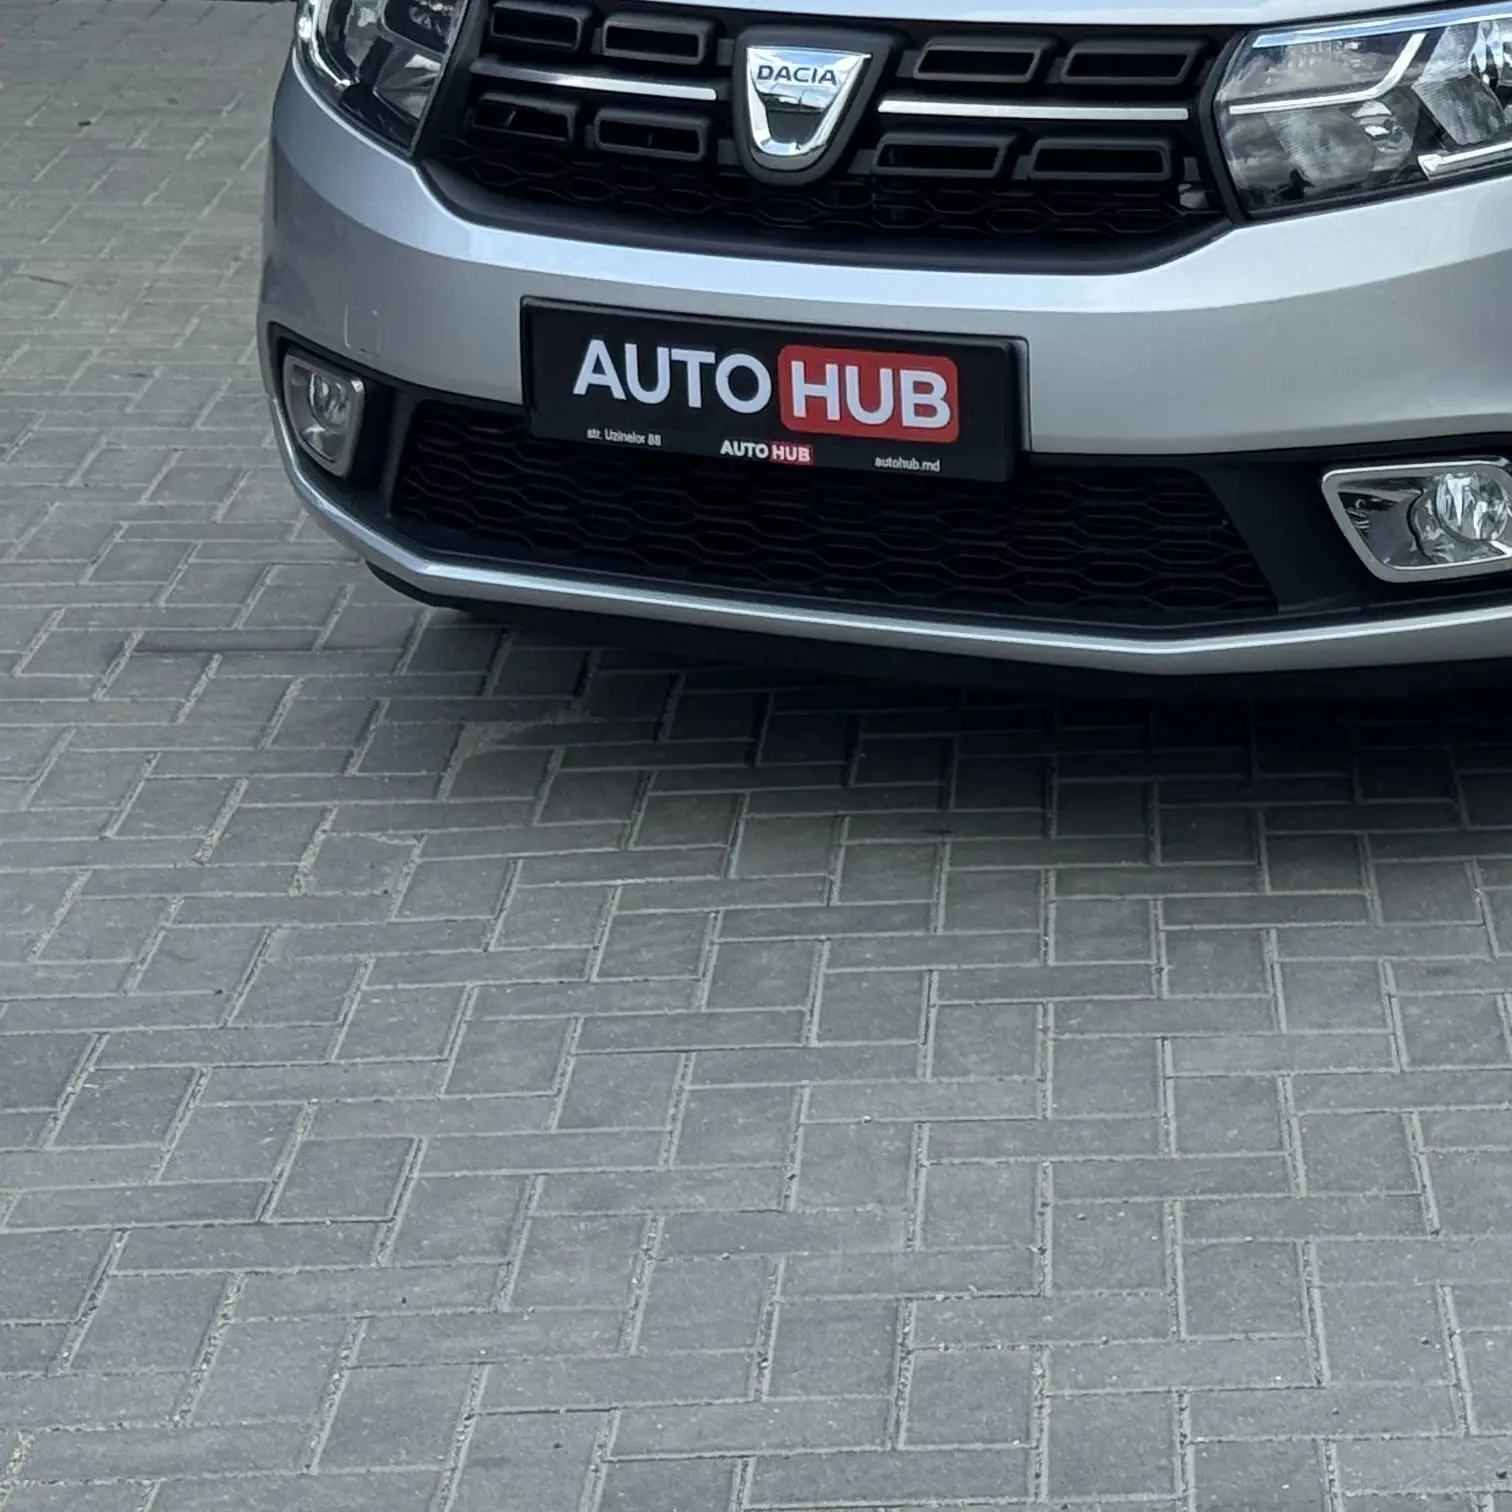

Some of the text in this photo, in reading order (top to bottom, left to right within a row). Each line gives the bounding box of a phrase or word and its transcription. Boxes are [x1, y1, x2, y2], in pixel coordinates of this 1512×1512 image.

[757, 64, 839, 86] DACIA
[572, 339, 951, 430] AUTO HUB
[720, 439, 810, 462] AUTO HUB
[875, 456, 941, 472] autohub.md
